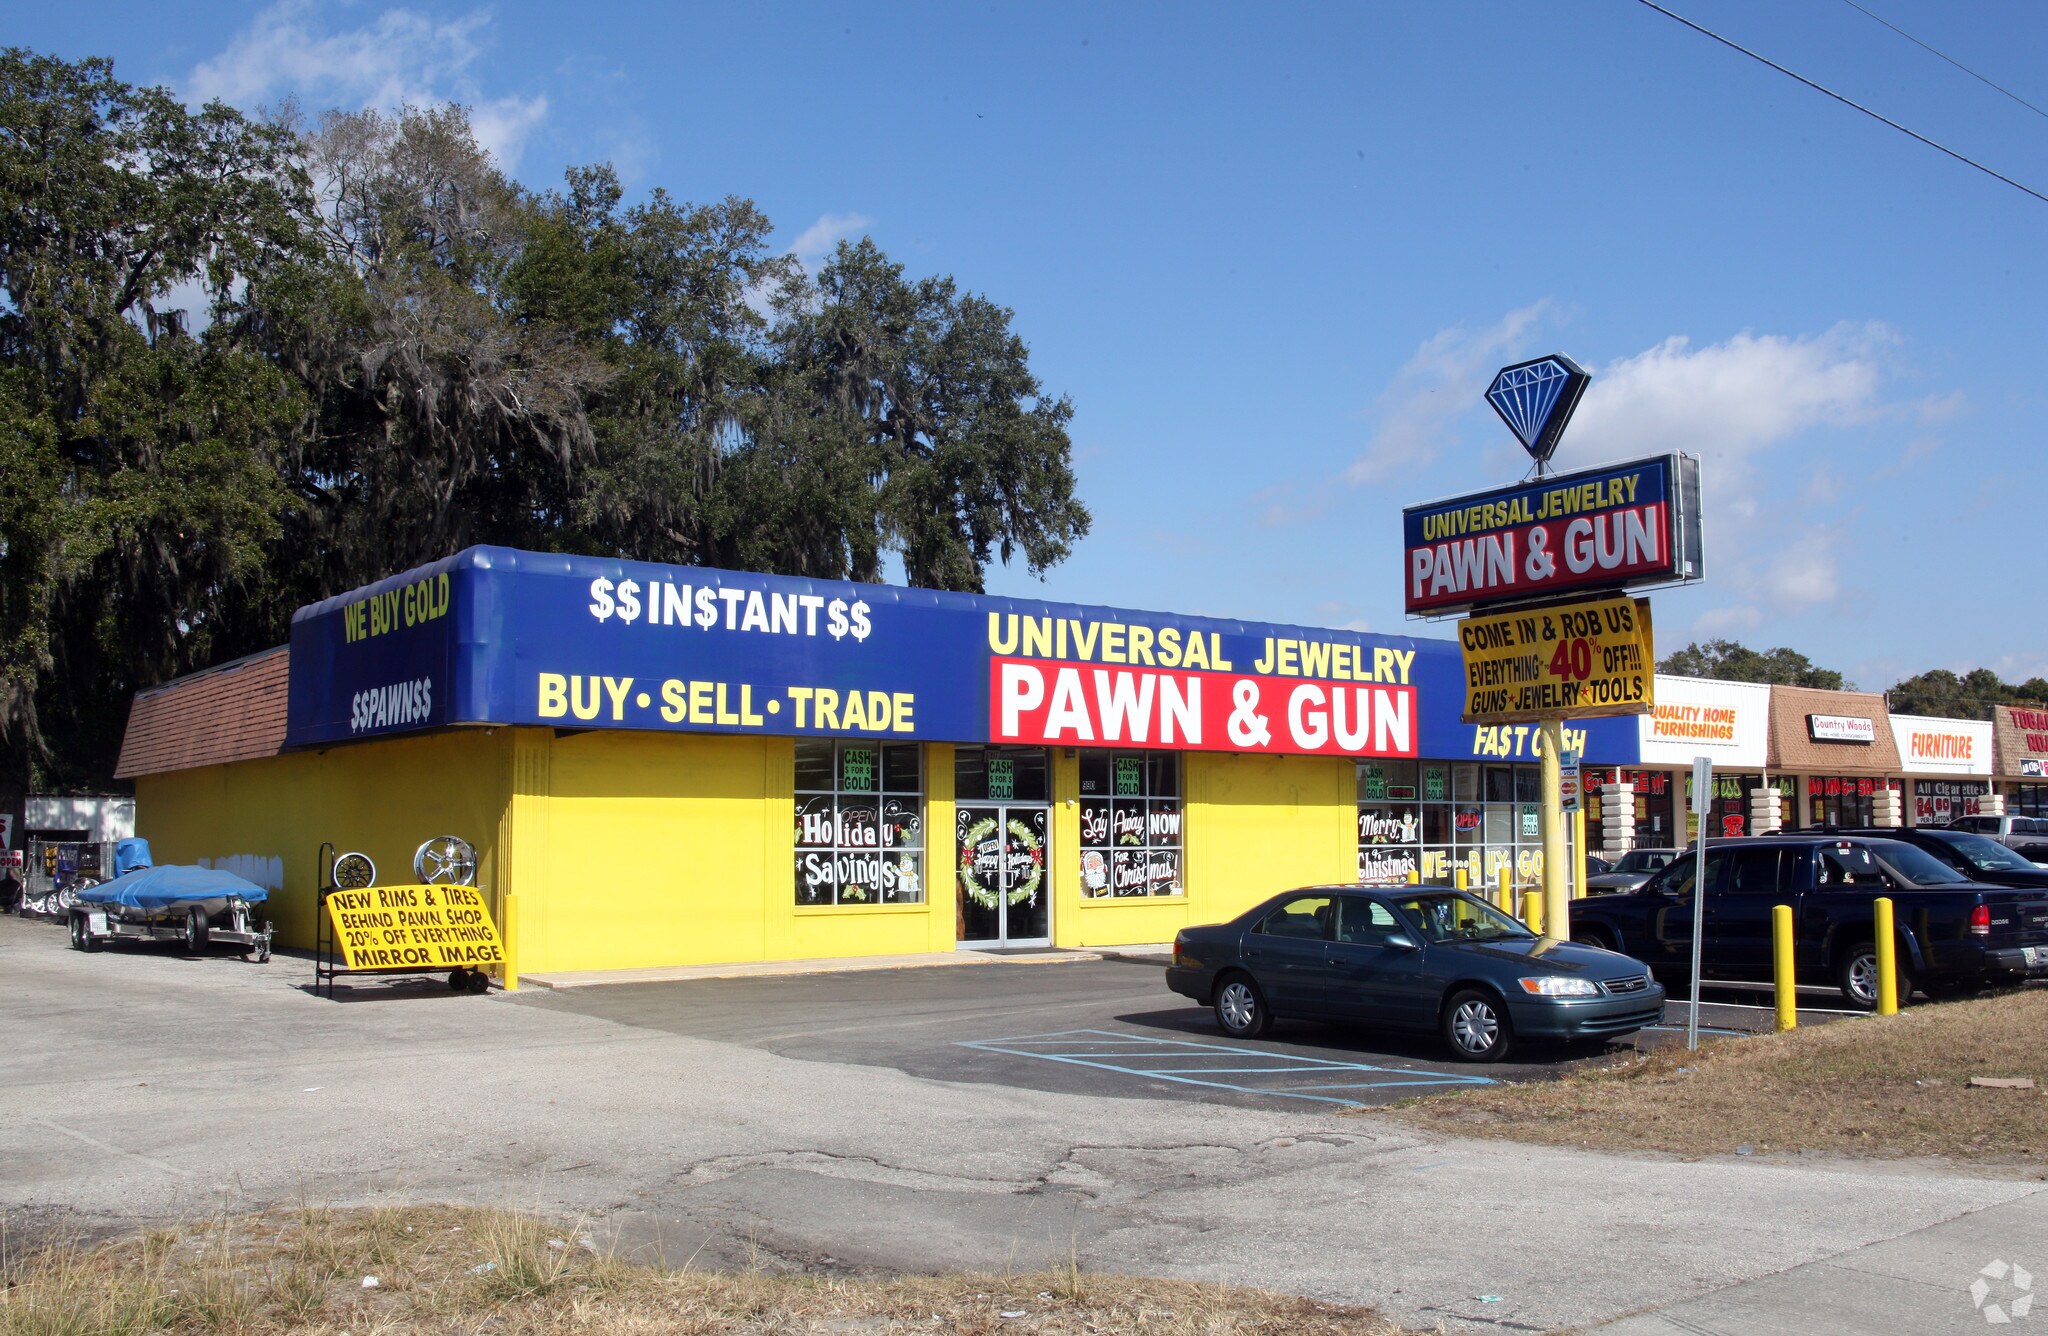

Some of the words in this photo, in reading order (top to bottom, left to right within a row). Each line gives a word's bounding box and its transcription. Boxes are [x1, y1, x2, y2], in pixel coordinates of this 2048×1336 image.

[1423, 496, 1533, 541] UNIVERSAL
[1536, 473, 1639, 519] JEWELRY
[1413, 532, 1515, 599] PAWN
[1525, 526, 1555, 580] &
[1564, 506, 1658, 574] GUN
[344, 600, 366, 643] WE
[370, 588, 400, 637] BUY
[404, 572, 450, 627] GOLD
[1462, 621, 1514, 651] COME
[1516, 618, 1536, 644] IN
[1542, 616, 1556, 641] &
[1560, 610, 1603, 639] ROB
[1604, 606, 1633, 633] US
[988, 612, 1232, 671] UNIVERSAL
[1254, 636, 1416, 685] JEWELRY
[1469, 654, 1539, 687] EVERYTHING
[1604, 644, 1642, 673] OFF!!!
[538, 672, 634, 720] BUY
[660, 678, 764, 726] SELL
[788, 686, 914, 732] TRADE
[1471, 689, 1507, 714] GUNS
[1515, 682, 1581, 710] JEWELRY
[1590, 676, 1643, 703] TOOLS
[1001, 664, 1201, 744] PAWN
[1227, 679, 1271, 748] &
[1288, 684, 1410, 753] GUN
[1650, 704, 1700, 722] QUALITY
[1703, 708, 1735, 724] HOME
[1654, 721, 1733, 740] FURNISHINGS
[1814, 717, 1844, 732] Country
[1847, 720, 1871, 731] Woods
[1473, 724, 1528, 758] FA$T
[1531, 726, 1586, 758] CSH
[1912, 732, 1972, 759] FURNITURE
[844, 751, 870, 764] CASH
[989, 761, 1012, 774] CASH
[1117, 760, 1138, 772] CASH
[1366, 768, 1383, 778] CASH
[1427, 770, 1443, 779] CASH
[844, 777, 870, 790] GOLD
[990, 785, 1012, 798] GOLD
[1117, 783, 1138, 795] GOLD
[1918, 783, 1930, 794] All
[1935, 782, 1984, 795] Cigarettes
[1366, 789, 1383, 799] GOLD
[1427, 790, 1443, 799] GOLD
[842, 810, 878, 823] OPEN
[1082, 808, 1108, 838] Lay
[1114, 810, 1144, 835] Away
[1150, 814, 1180, 835] NOW
[1359, 814, 1400, 839] Merry
[1455, 813, 1479, 827] OPEN
[802, 813, 894, 846] Holiday
[983, 841, 998, 852] OPEN
[0, 858, 21, 866] OPEN
[1114, 852, 1130, 862] FOR
[1358, 852, 1416, 879] Christmas
[1423, 850, 1447, 878] WE
[1469, 850, 1509, 879] BUY
[1519, 850, 1544, 877] GO
[806, 853, 895, 890] Savings
[333, 892, 371, 910] NEW
[378, 889, 418, 907] RIMS
[425, 889, 436, 906] &
[442, 887, 479, 906] TIRES
[341, 913, 393, 929] BEHIND
[398, 910, 442, 926] PAWN
[447, 909, 482, 924] SHOP
[346, 930, 378, 947] 20%
[384, 929, 407, 944] OFF
[412, 926, 493, 943] EVERYTHING
[353, 949, 433, 967] MIRROR
[439, 945, 502, 962] IMAGE
